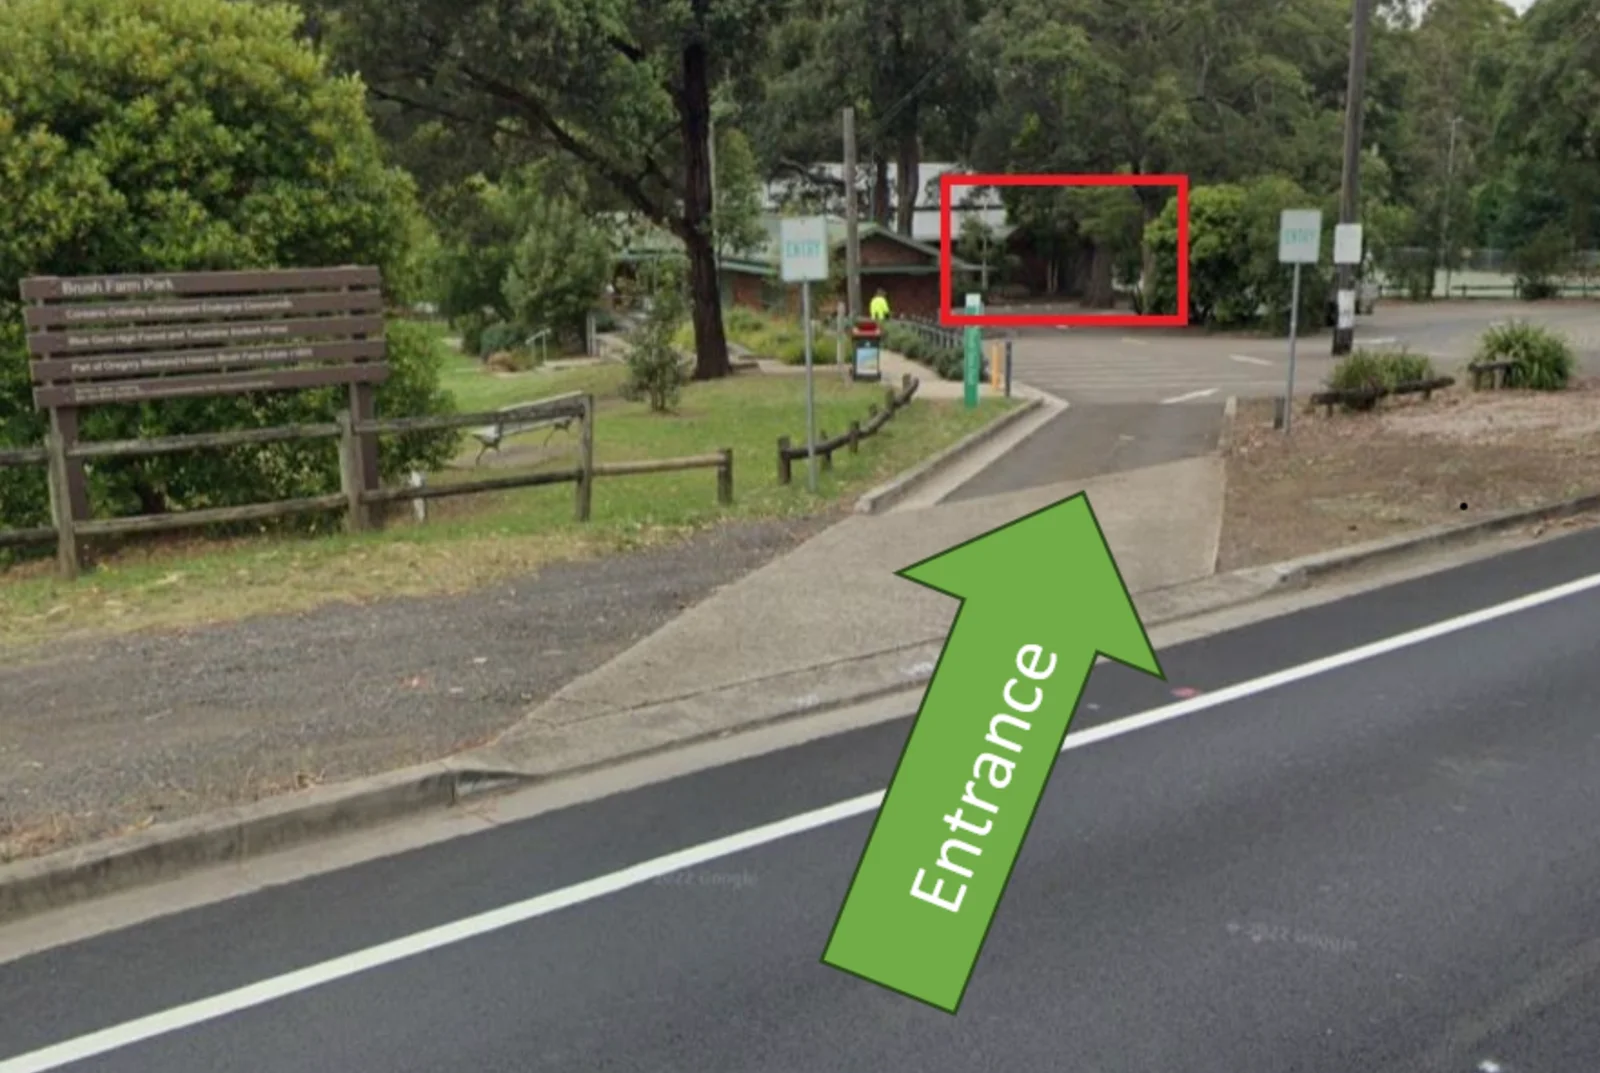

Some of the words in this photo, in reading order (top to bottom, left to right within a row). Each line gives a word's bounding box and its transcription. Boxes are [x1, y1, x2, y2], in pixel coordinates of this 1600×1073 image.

[62, 279, 103, 296] Brush
[105, 278, 140, 294] Farm
[143, 277, 174, 293] Park
